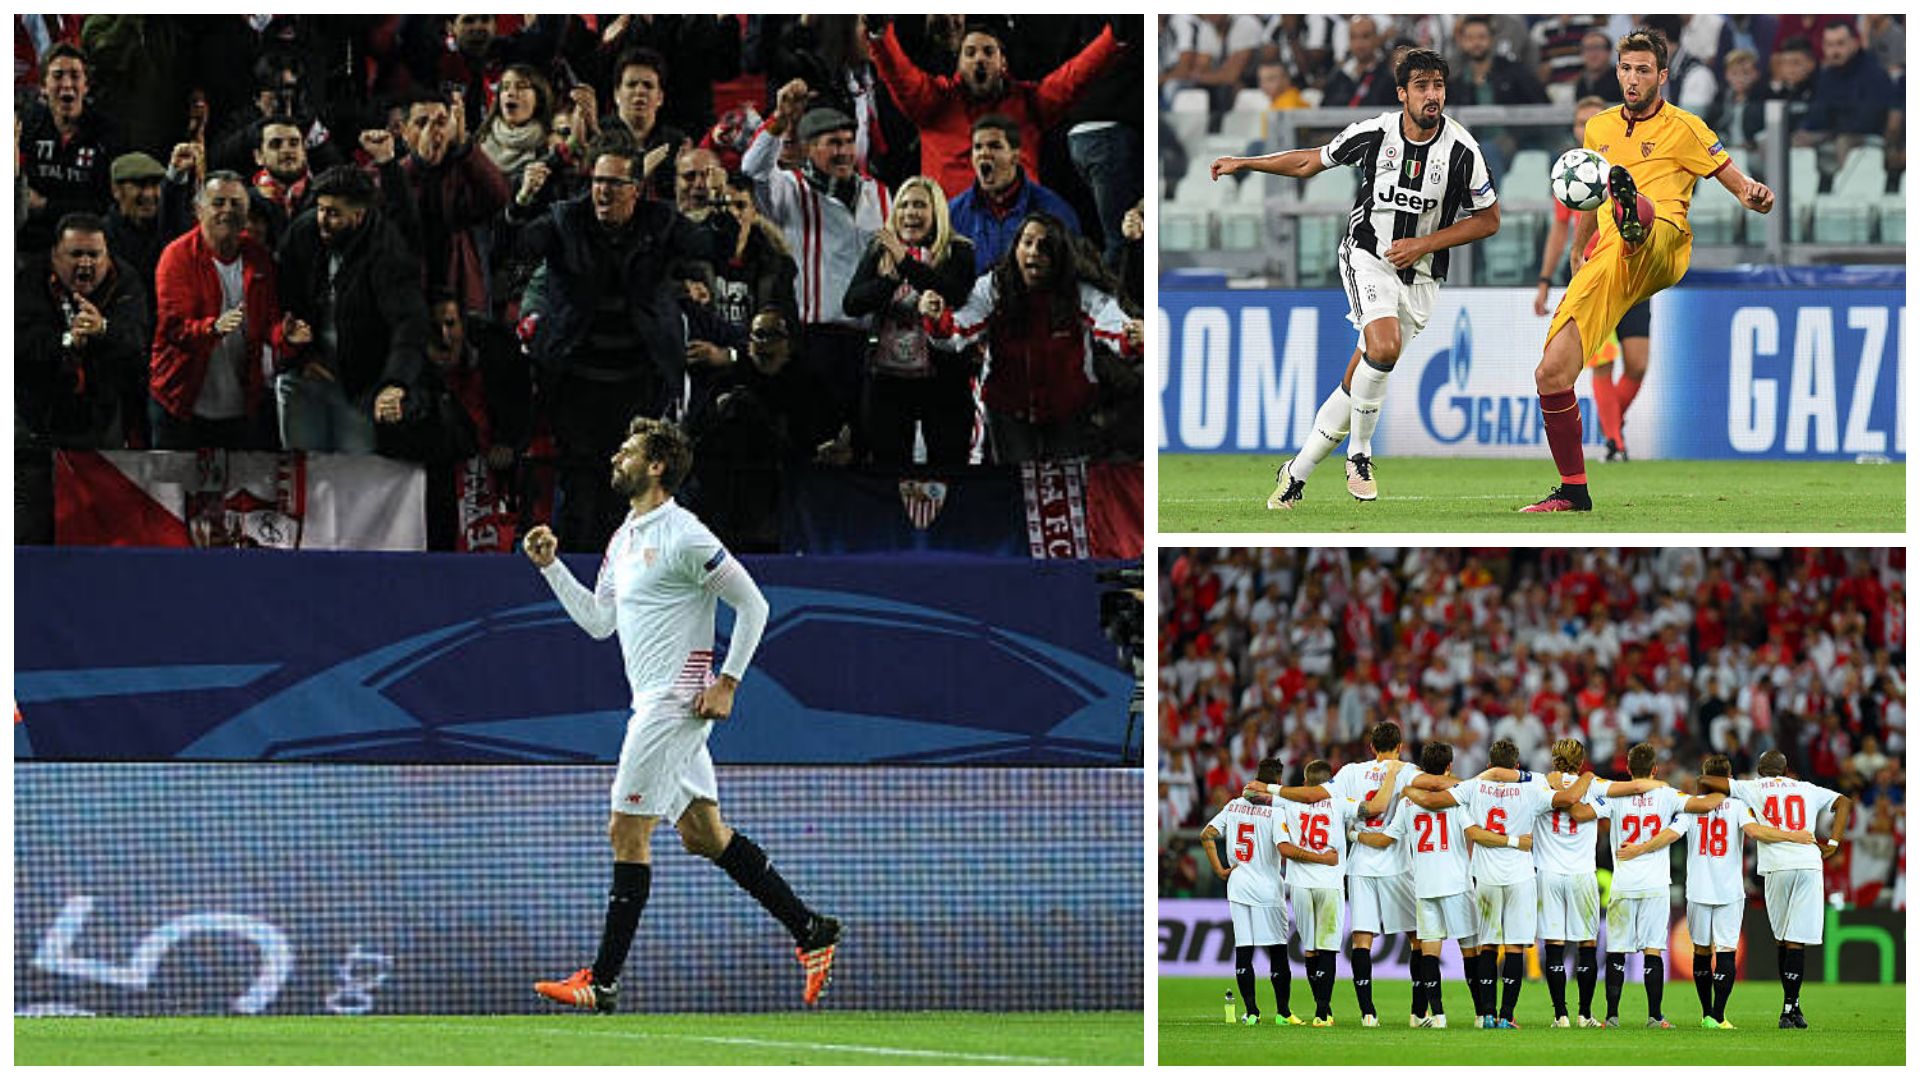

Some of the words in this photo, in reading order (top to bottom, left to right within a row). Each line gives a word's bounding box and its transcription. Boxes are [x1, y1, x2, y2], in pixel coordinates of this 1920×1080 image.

[1379, 185, 1438, 213] Jeep
[1158, 306, 1319, 449] OM
[1728, 306, 1906, 453] GAZ
[1299, 813, 1330, 850] 16
[1486, 806, 1507, 835] 6
[1620, 814, 1662, 849] 23
[1763, 794, 1806, 831] 40
[1235, 823, 1255, 863] 5
[1414, 811, 1448, 853] 21
[1697, 815, 1728, 857] 18
